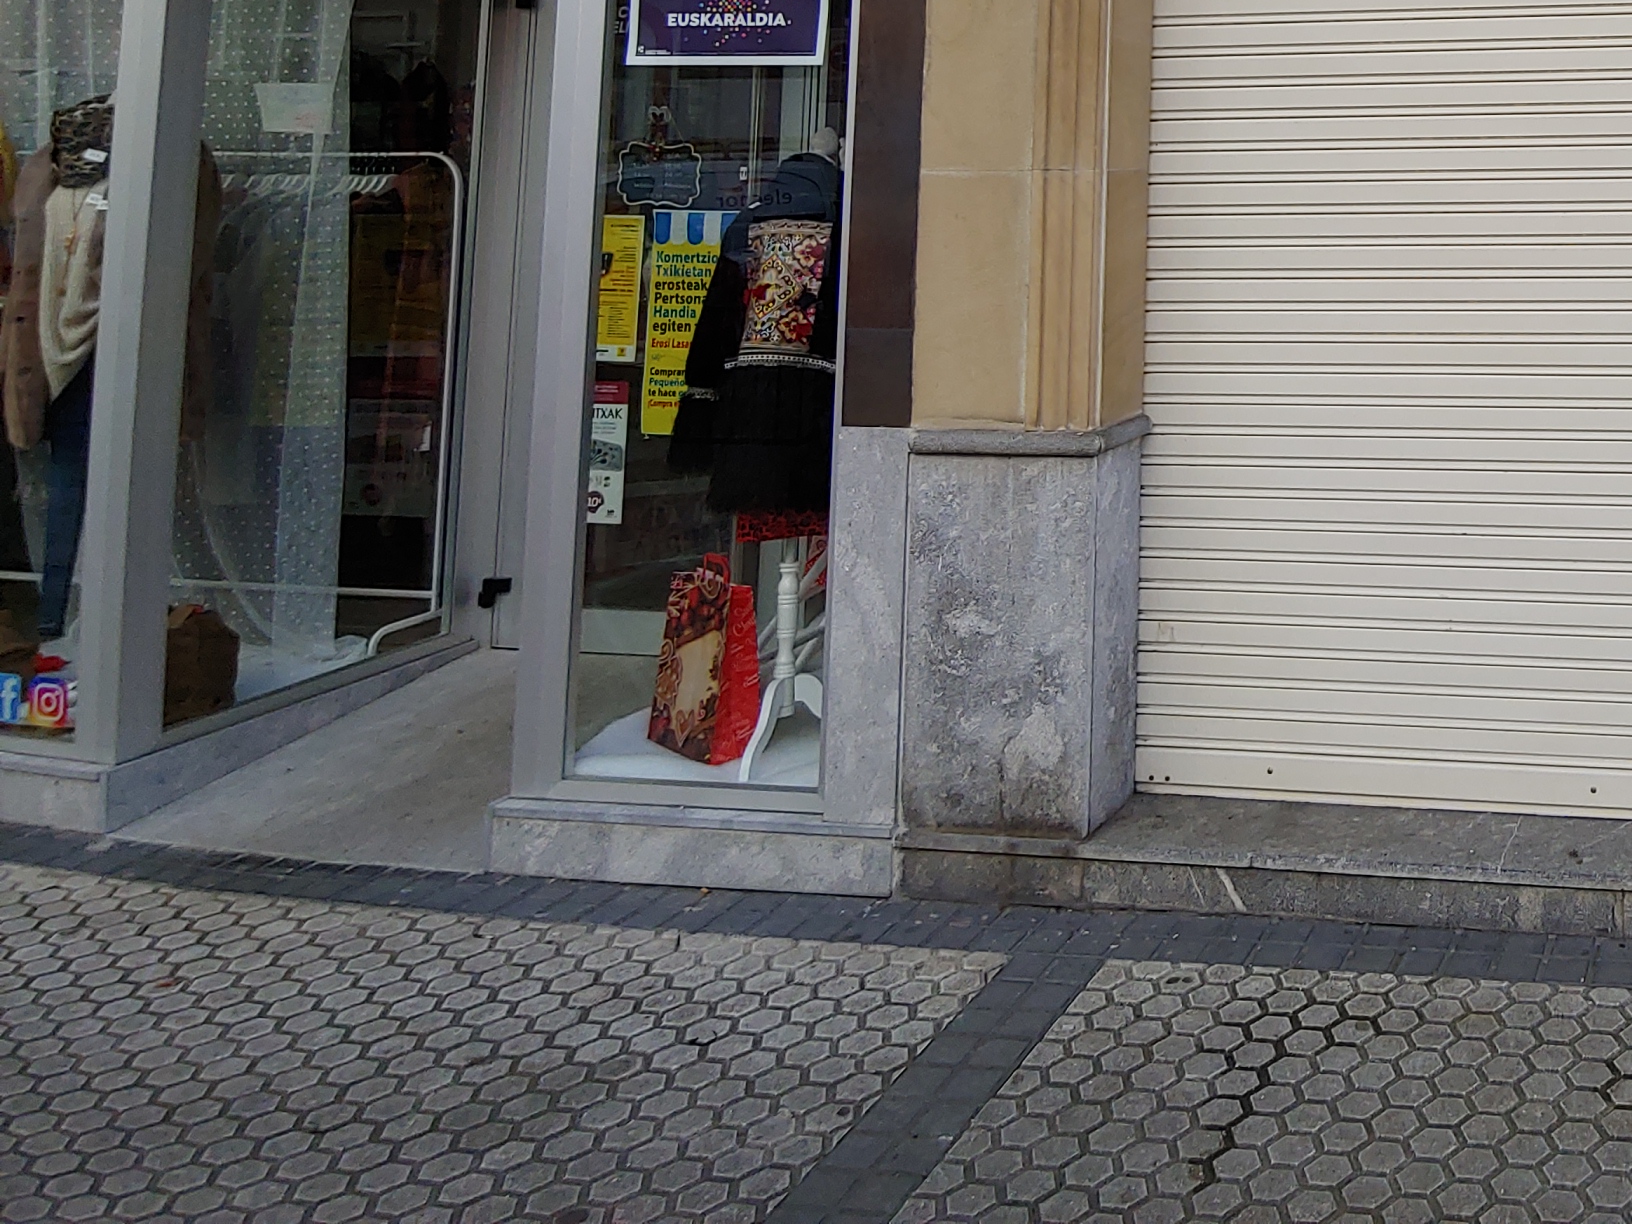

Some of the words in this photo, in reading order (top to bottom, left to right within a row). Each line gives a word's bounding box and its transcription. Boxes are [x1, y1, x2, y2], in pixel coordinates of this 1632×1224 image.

[667, 12, 787, 27] EUSKARALDIA
[656, 250, 719, 264] Komertzio
[655, 264, 712, 278] Txikietan
[654, 278, 708, 291] erosteak
[653, 306, 696, 319] Handia
[652, 319, 691, 335] egiten
[651, 338, 670, 349] Erosi
[672, 338, 691, 349] Lasa
[648, 388, 657, 397] te
[657, 388, 677, 397] hace
